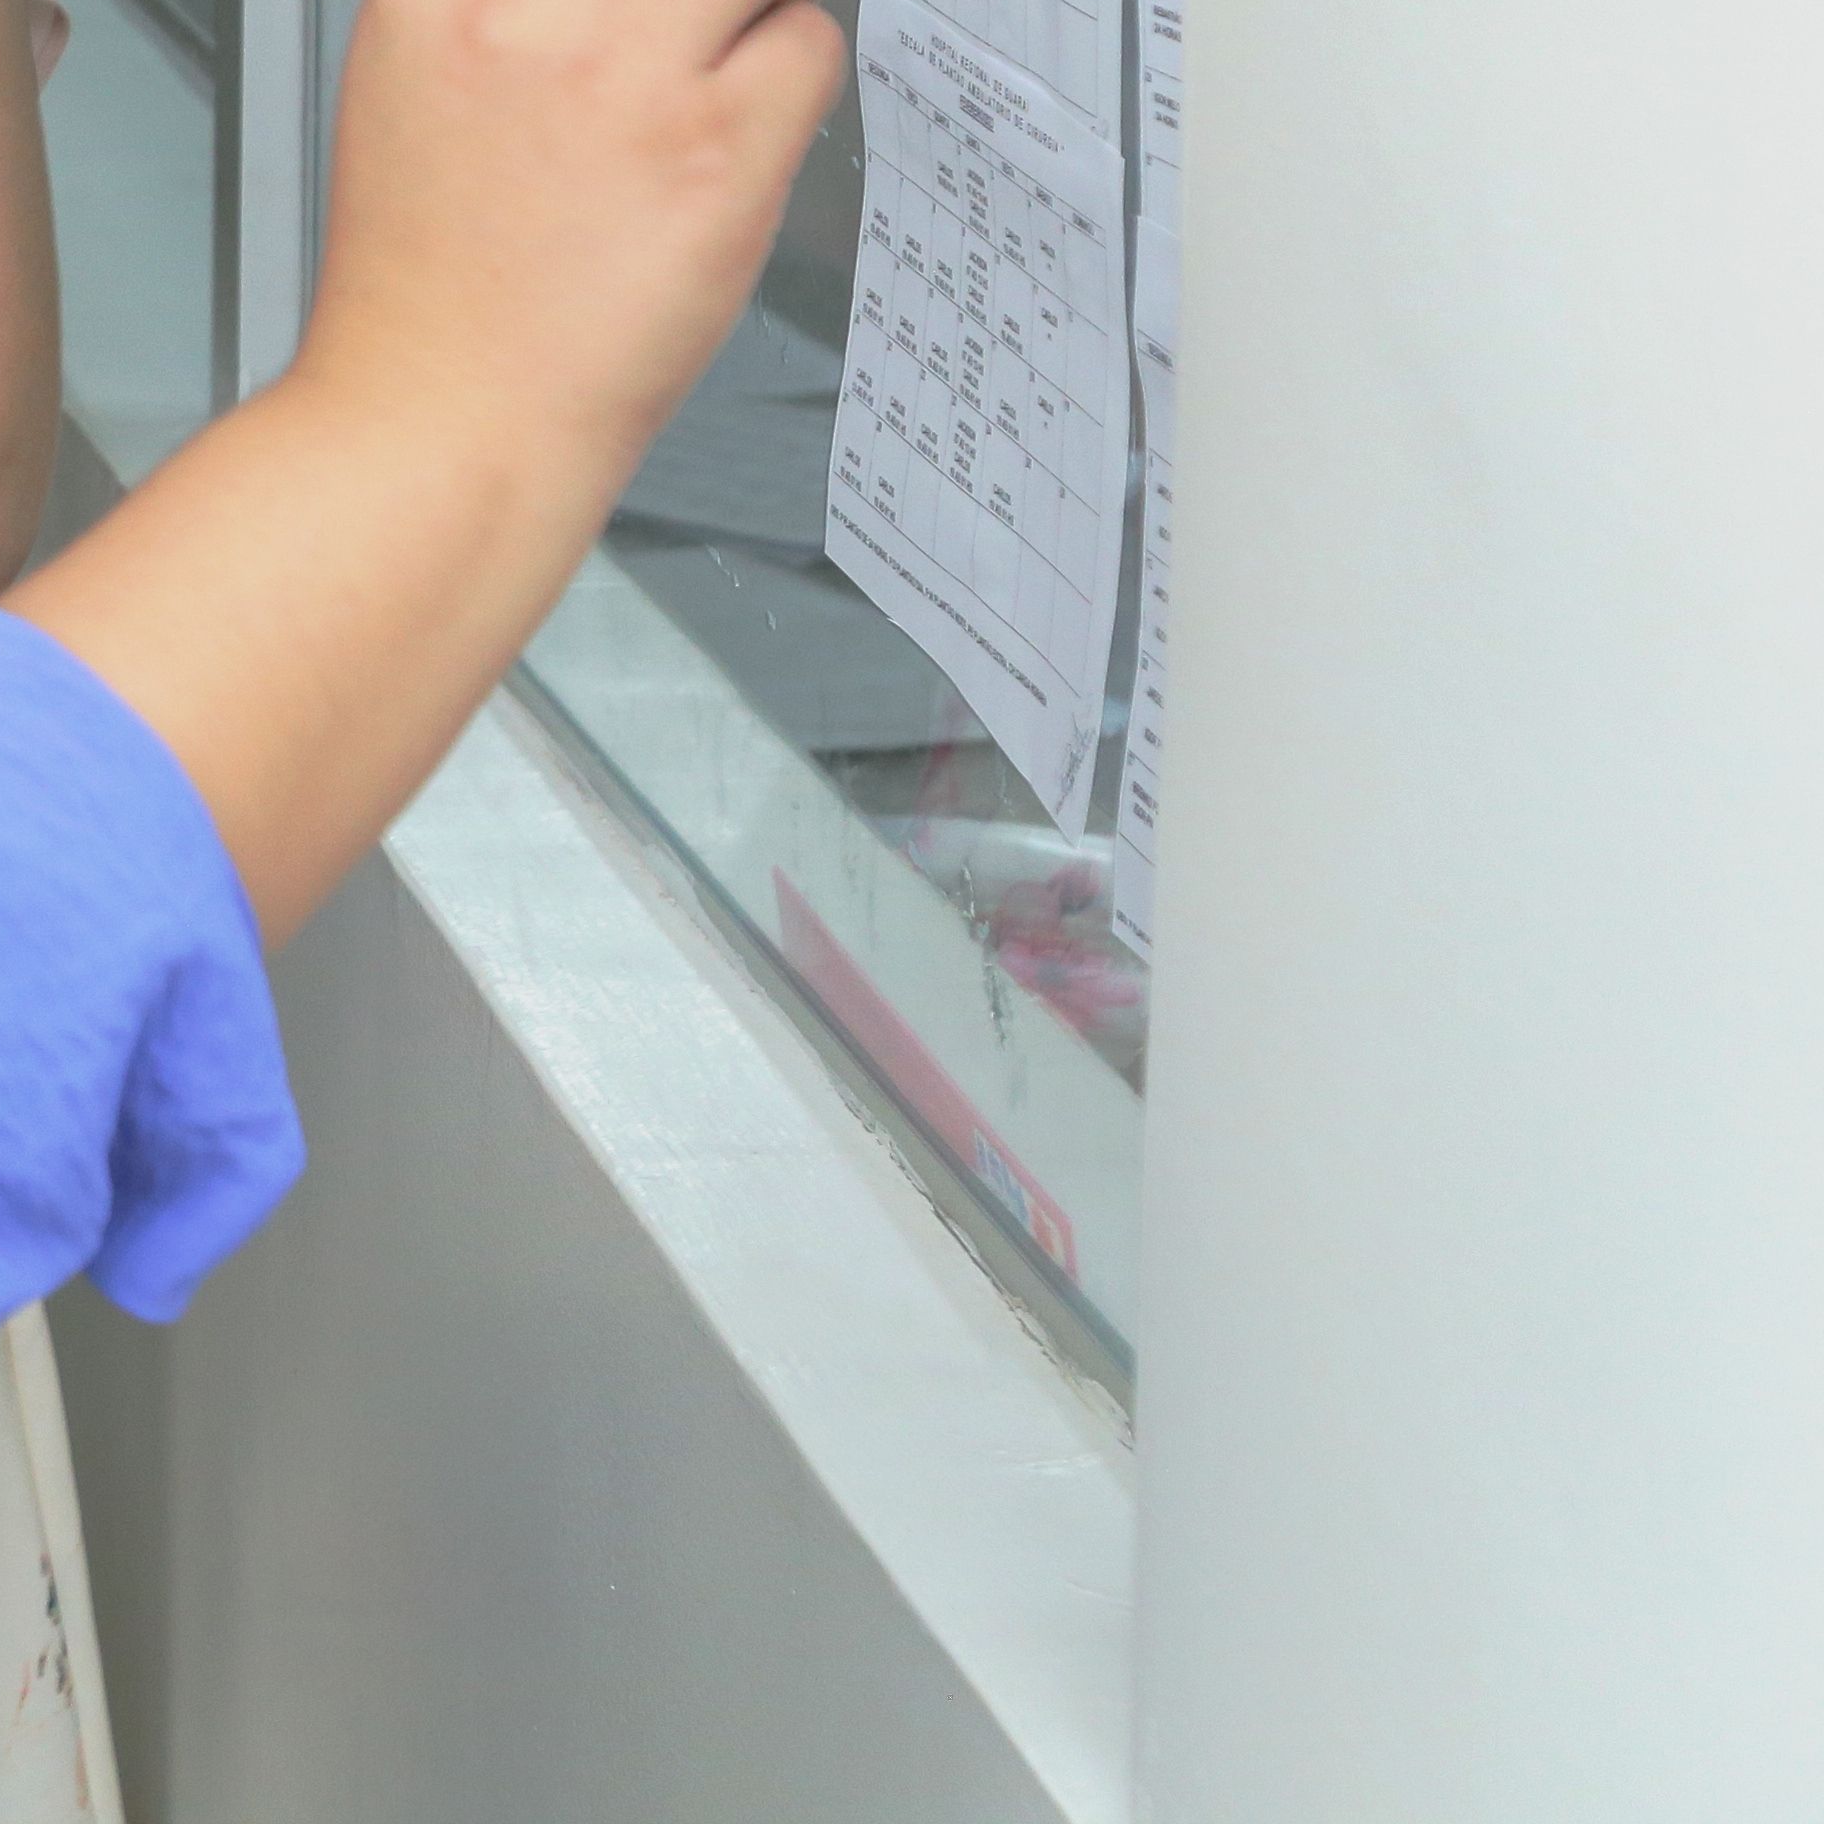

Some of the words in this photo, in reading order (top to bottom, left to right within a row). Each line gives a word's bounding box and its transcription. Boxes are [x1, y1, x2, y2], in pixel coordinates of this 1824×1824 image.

[928, 50, 937, 67] DE
[1014, 114, 1024, 131] DE
[960, 55, 991, 87] REGIONAL
[993, 79, 1003, 96] DE
